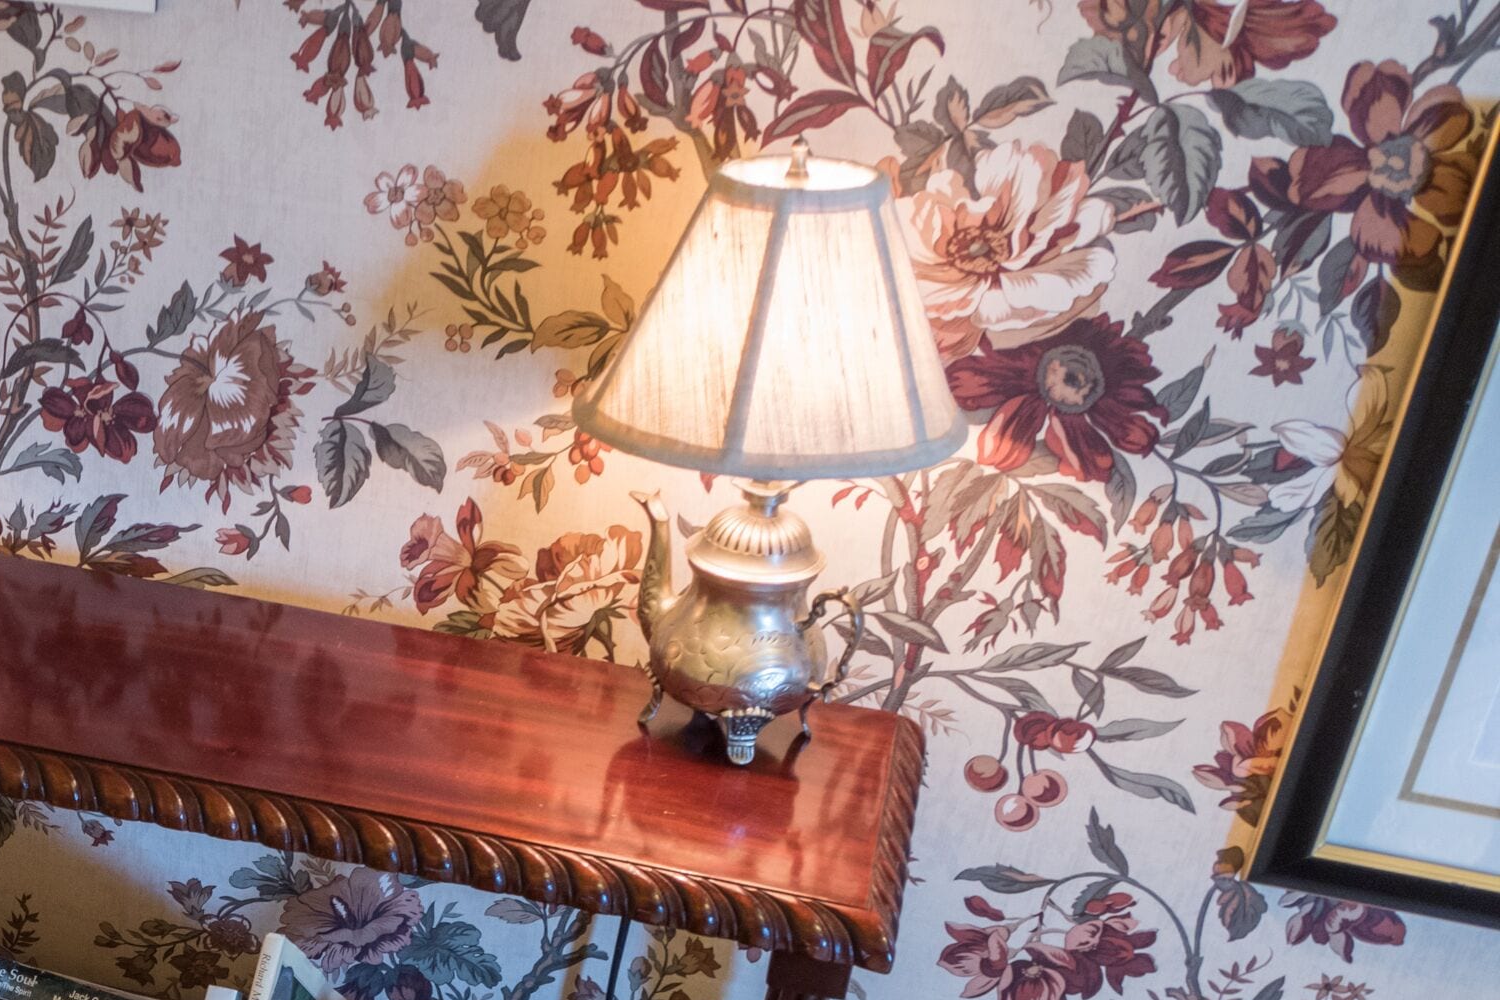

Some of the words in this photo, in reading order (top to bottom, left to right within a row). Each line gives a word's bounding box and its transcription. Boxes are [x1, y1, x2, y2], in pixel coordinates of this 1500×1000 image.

[9, 969, 39, 988] Soul
[255, 953, 271, 989] Richard
[2, 981, 14, 992] The
[15, 985, 32, 998] Spirit
